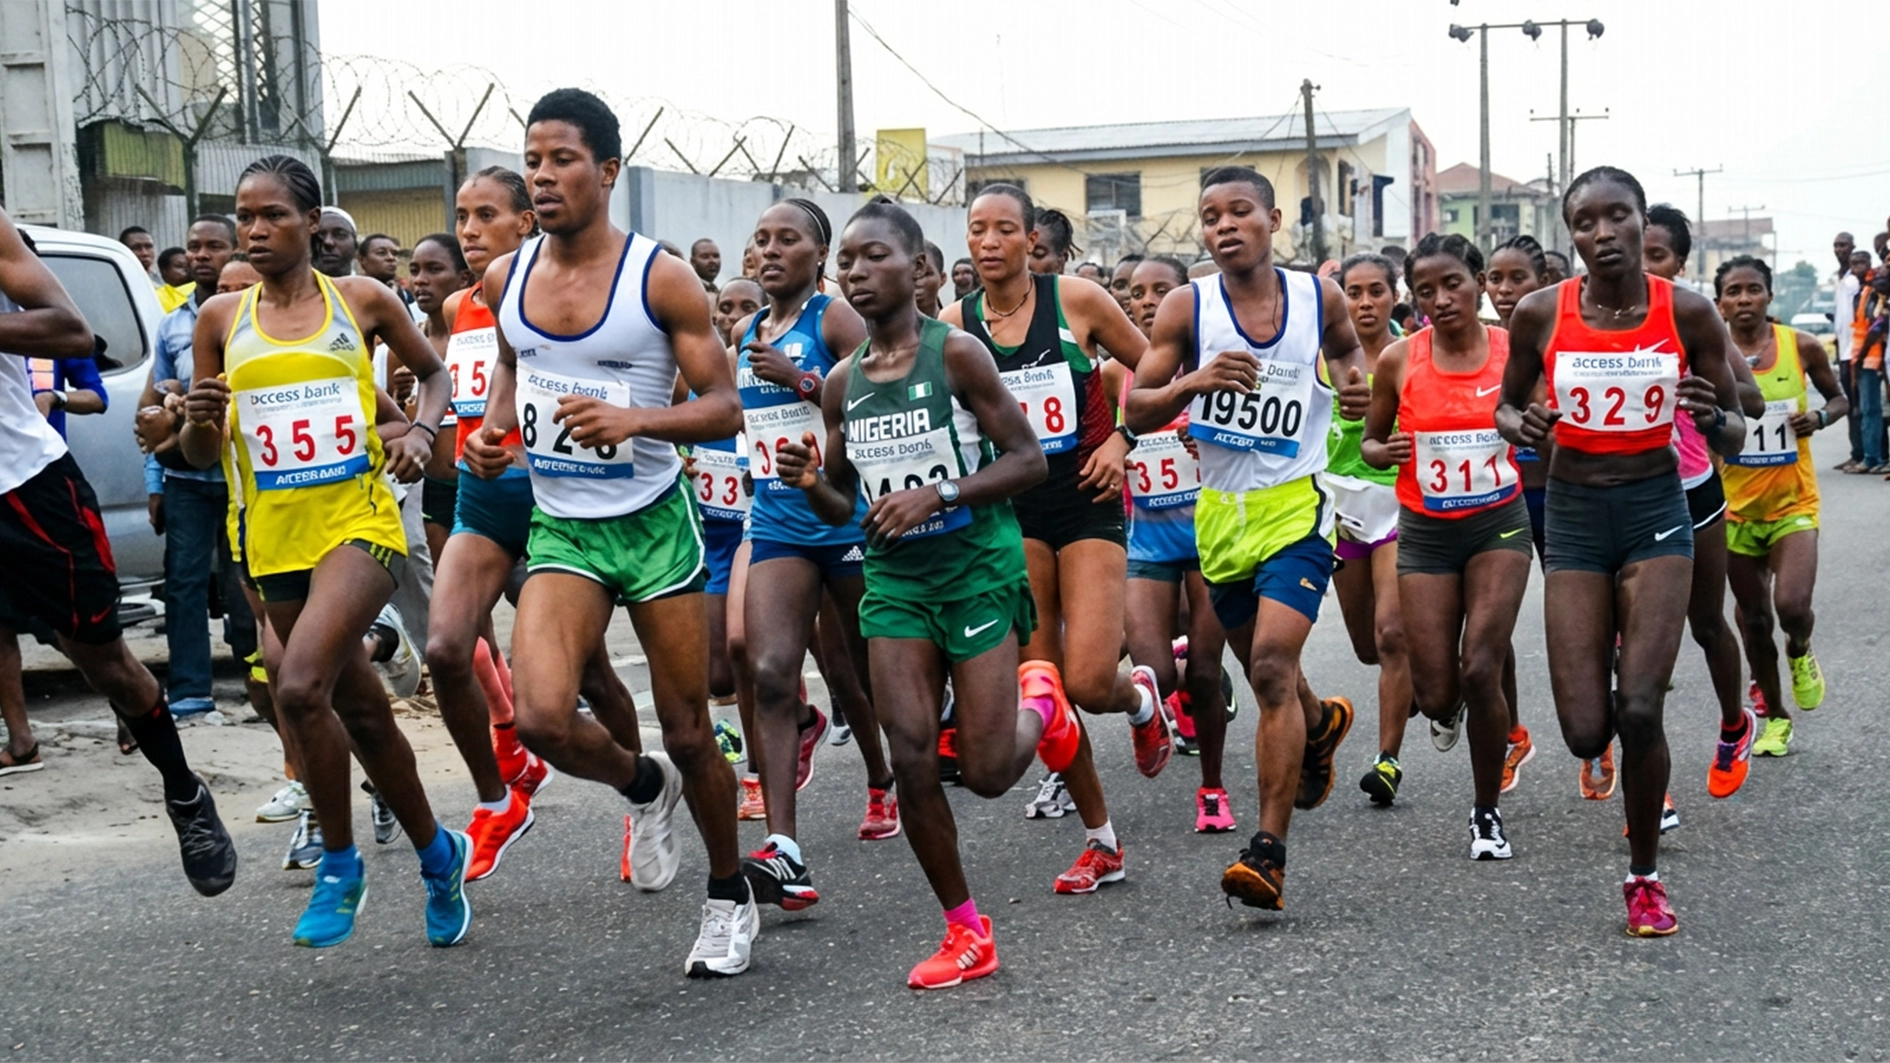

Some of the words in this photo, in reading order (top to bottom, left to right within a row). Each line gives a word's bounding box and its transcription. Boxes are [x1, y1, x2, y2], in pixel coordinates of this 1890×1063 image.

[1572, 357, 1623, 369] access
[304, 382, 341, 400] bank
[1569, 384, 1665, 426] 329
[848, 408, 931, 443] NIGERIA
[1200, 389, 1302, 438] 19500
[256, 414, 357, 467] 355
[1430, 453, 1502, 494] 311
